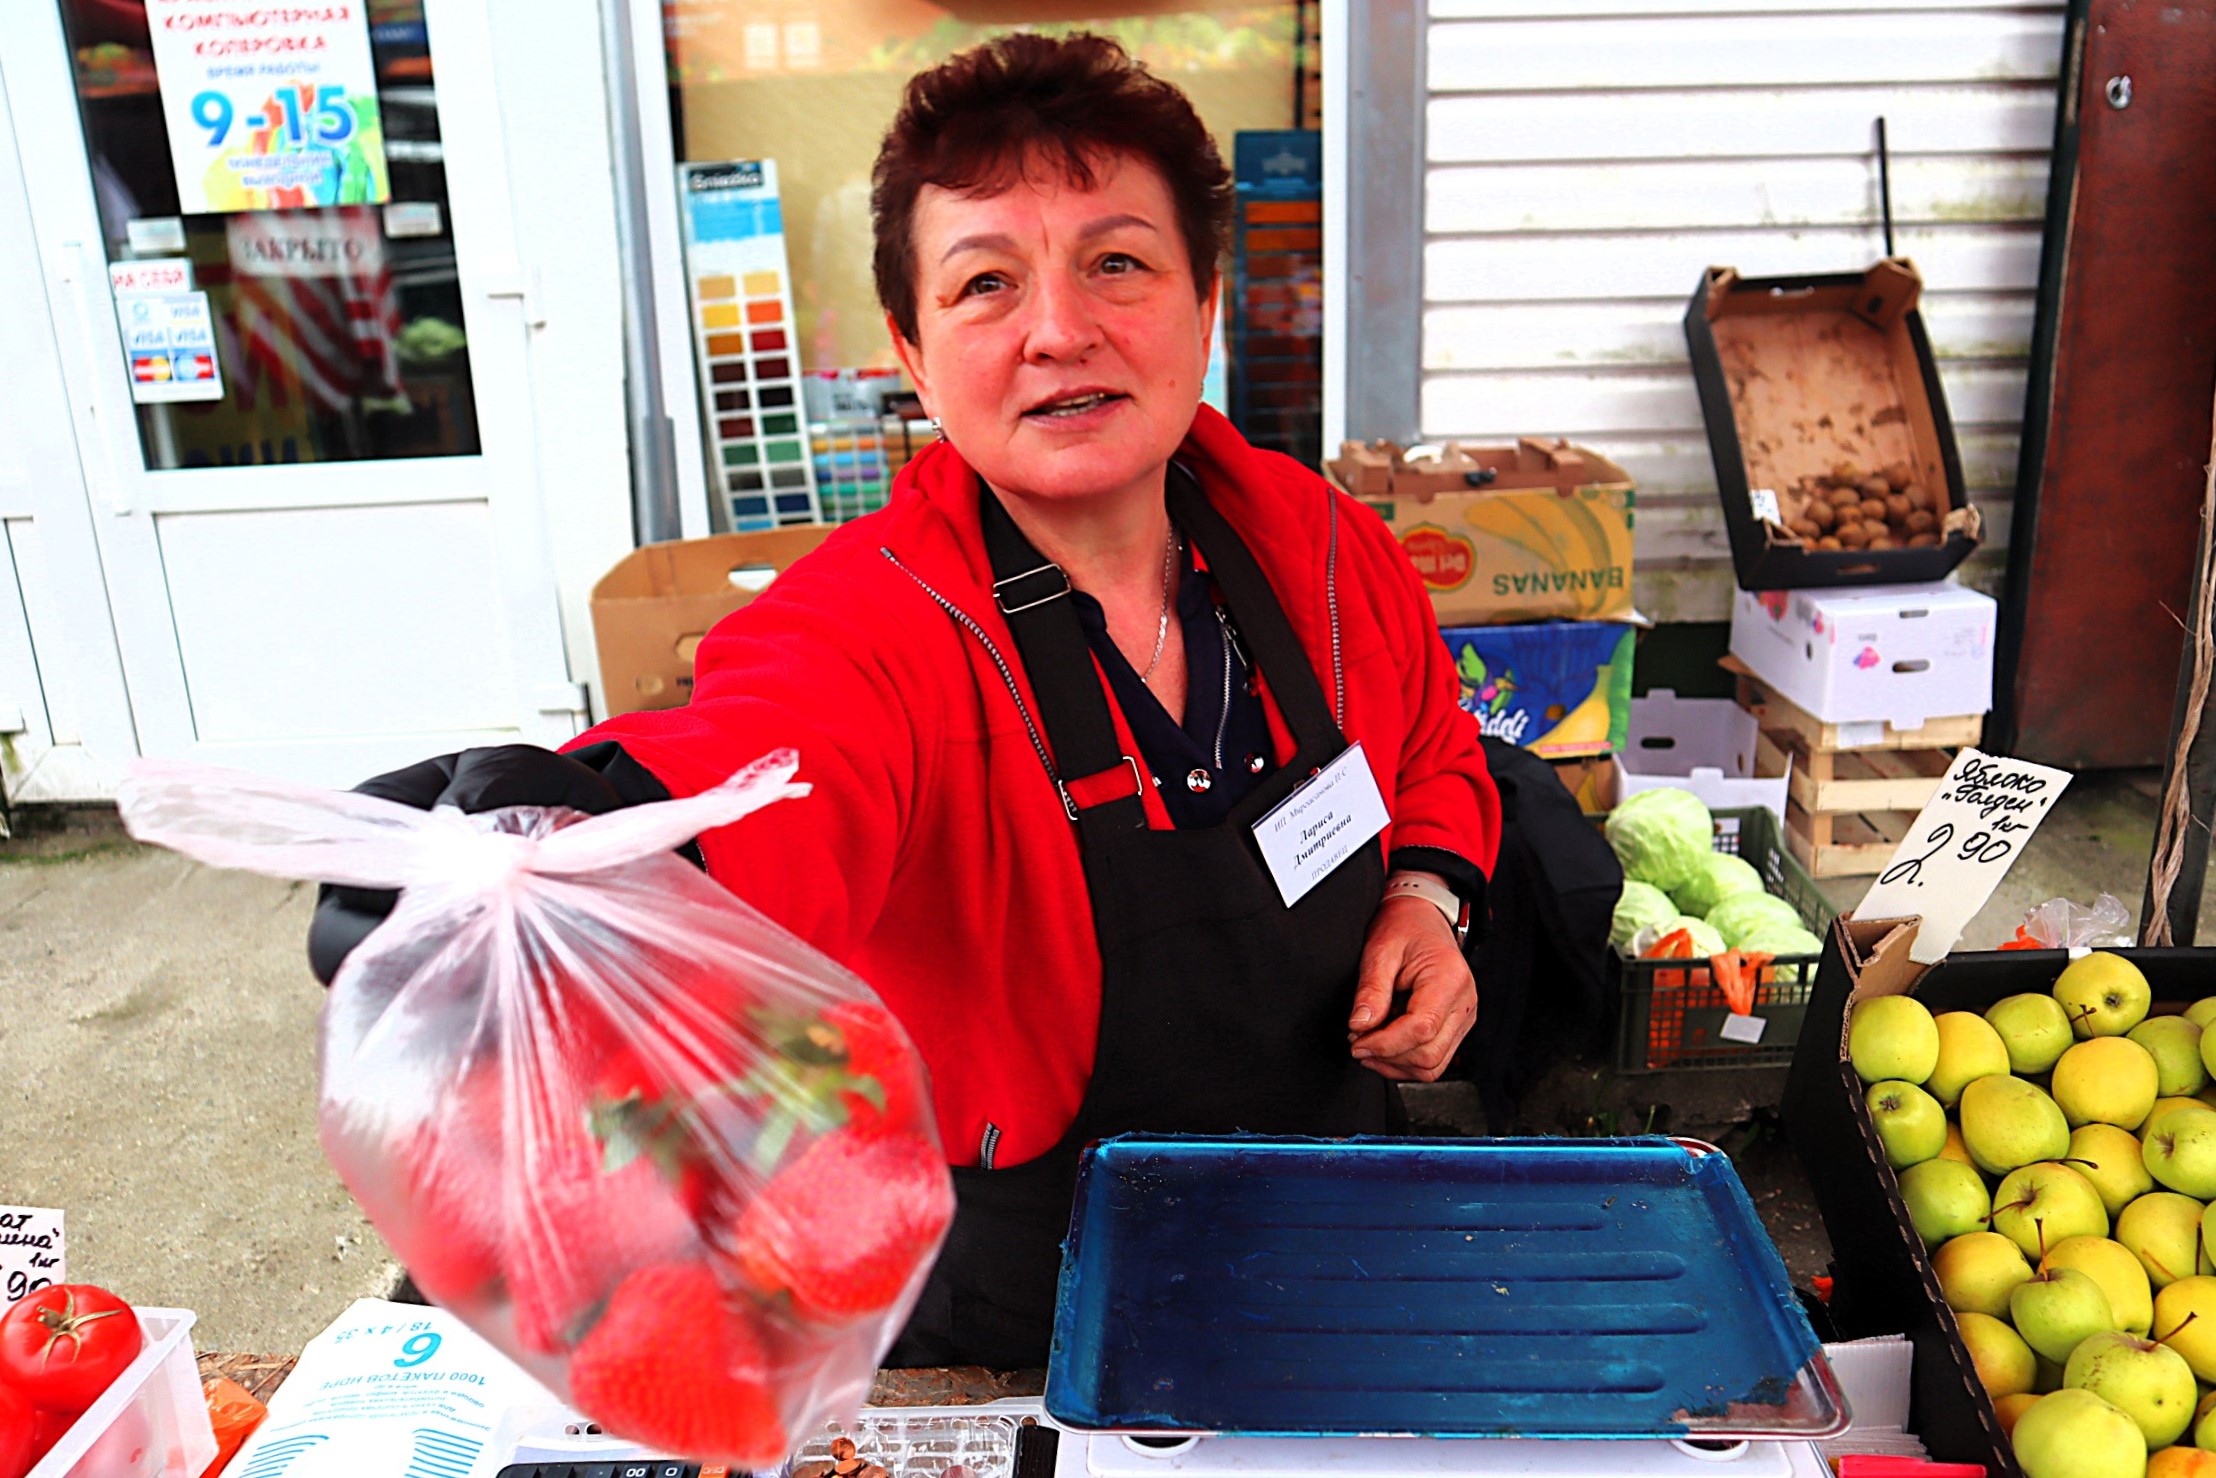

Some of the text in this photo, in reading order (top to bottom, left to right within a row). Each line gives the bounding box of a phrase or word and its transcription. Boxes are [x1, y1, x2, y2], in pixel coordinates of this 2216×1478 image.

[244, 235, 364, 263] ЗАКРЫТО
[1492, 566, 1624, 595] BANANAS
[1953, 758, 2046, 794] Яблоко
[1293, 814, 1352, 870] Дмитриевна
[1300, 810, 1334, 844] Лариса
[1957, 832, 2012, 863] 90
[393, 1332, 442, 1367] 6
[321, 1375, 364, 1391] HDPE
[367, 1371, 446, 1384] ПАКЕТОВ
[449, 1372, 486, 1386] 1000
